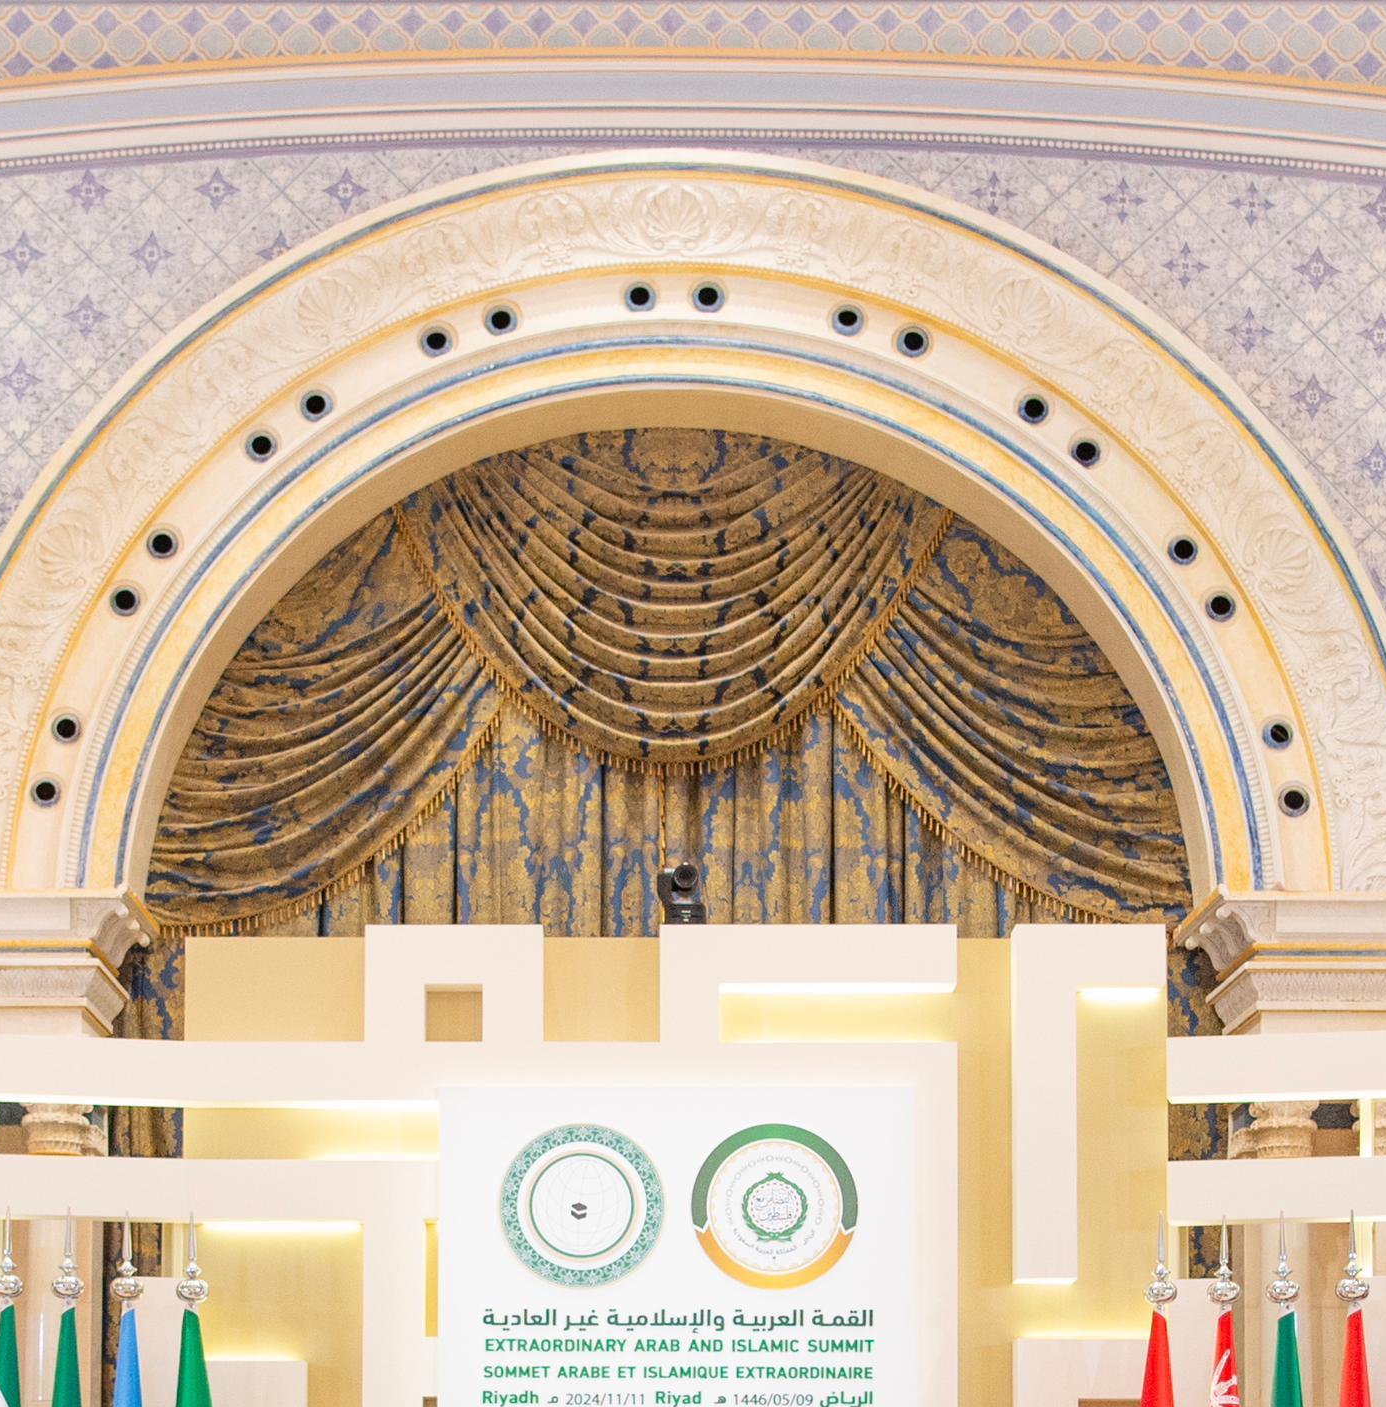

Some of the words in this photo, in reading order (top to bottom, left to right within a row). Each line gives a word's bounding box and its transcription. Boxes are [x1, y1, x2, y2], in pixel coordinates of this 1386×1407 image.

[482, 1308, 557, 1332] العادية
[563, 1309, 600, 1332] غير
[606, 1308, 725, 1334] والإسلامية
[732, 1308, 805, 1332] العربية
[811, 1308, 874, 1328] القمة
[484, 1338, 627, 1353] EXTRAORDINARY
[633, 1338, 681, 1353] ARAB
[688, 1338, 724, 1353] AND
[731, 1338, 800, 1353] ISLAMIC
[807, 1338, 875, 1353] SUMMIT
[483, 1365, 551, 1379] SOMMET
[556, 1365, 611, 1379] ARABE
[617, 1365, 637, 1379] ET
[643, 1365, 729, 1380] ISLAMIQUE
[735, 1365, 874, 1380] EXTRAORDINAIRE
[481, 1390, 540, 1407] Riyadh
[565, 1393, 646, 1406] 2024/11/11
[733, 1393, 814, 1407] 1446/05/09
